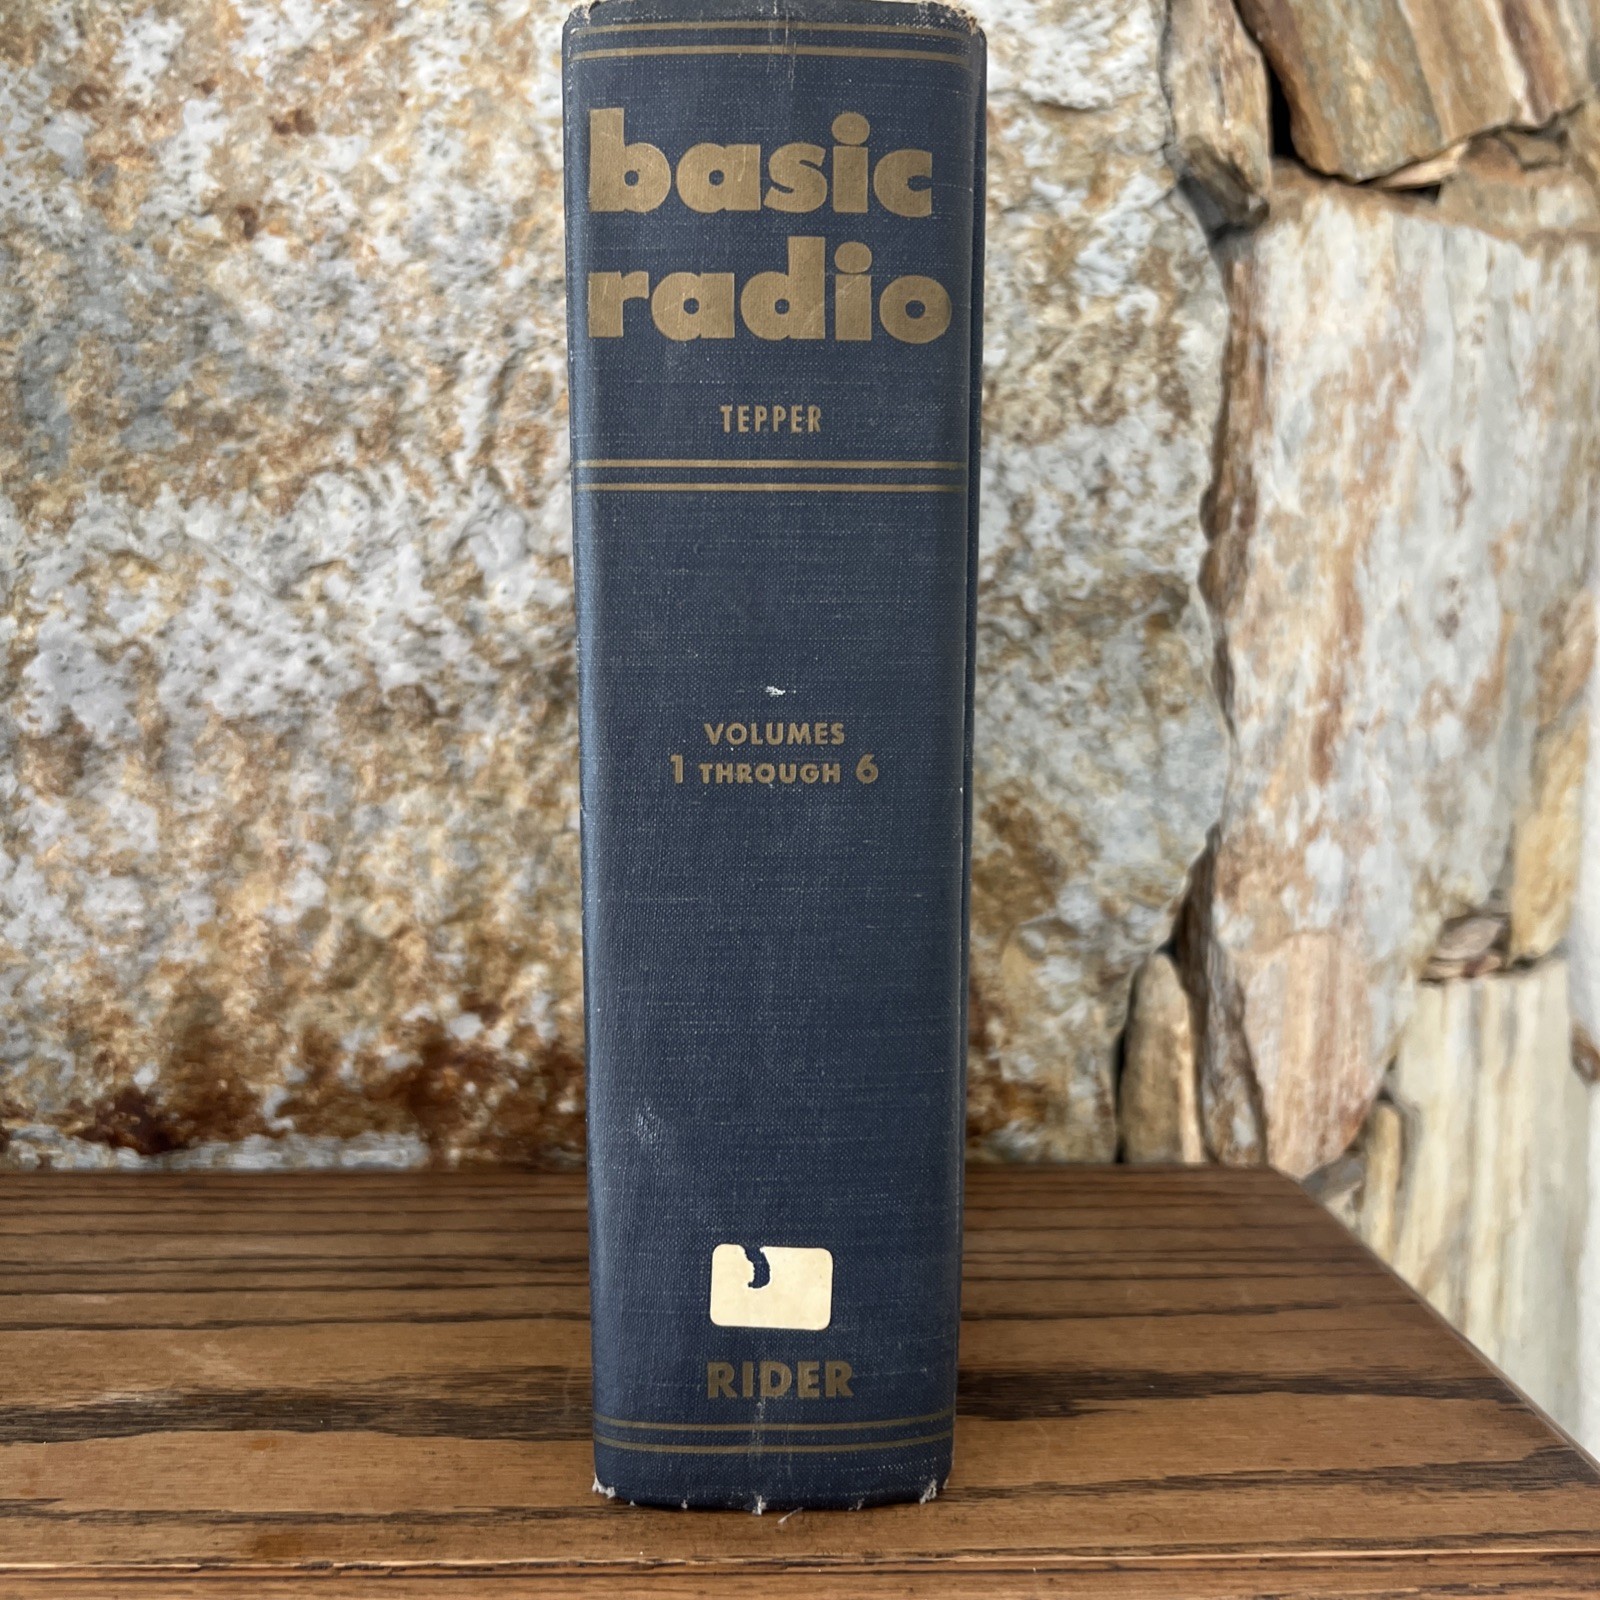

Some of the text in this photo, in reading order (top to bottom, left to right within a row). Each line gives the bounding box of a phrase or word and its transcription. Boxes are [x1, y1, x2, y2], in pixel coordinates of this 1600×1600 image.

[588, 106, 933, 219] basic
[587, 235, 953, 345] radio
[719, 403, 822, 434] TEPPER
[703, 720, 847, 747] VOLUMES
[669, 752, 879, 785] 1 THROUGH 6
[706, 1359, 854, 1401] RIDER
